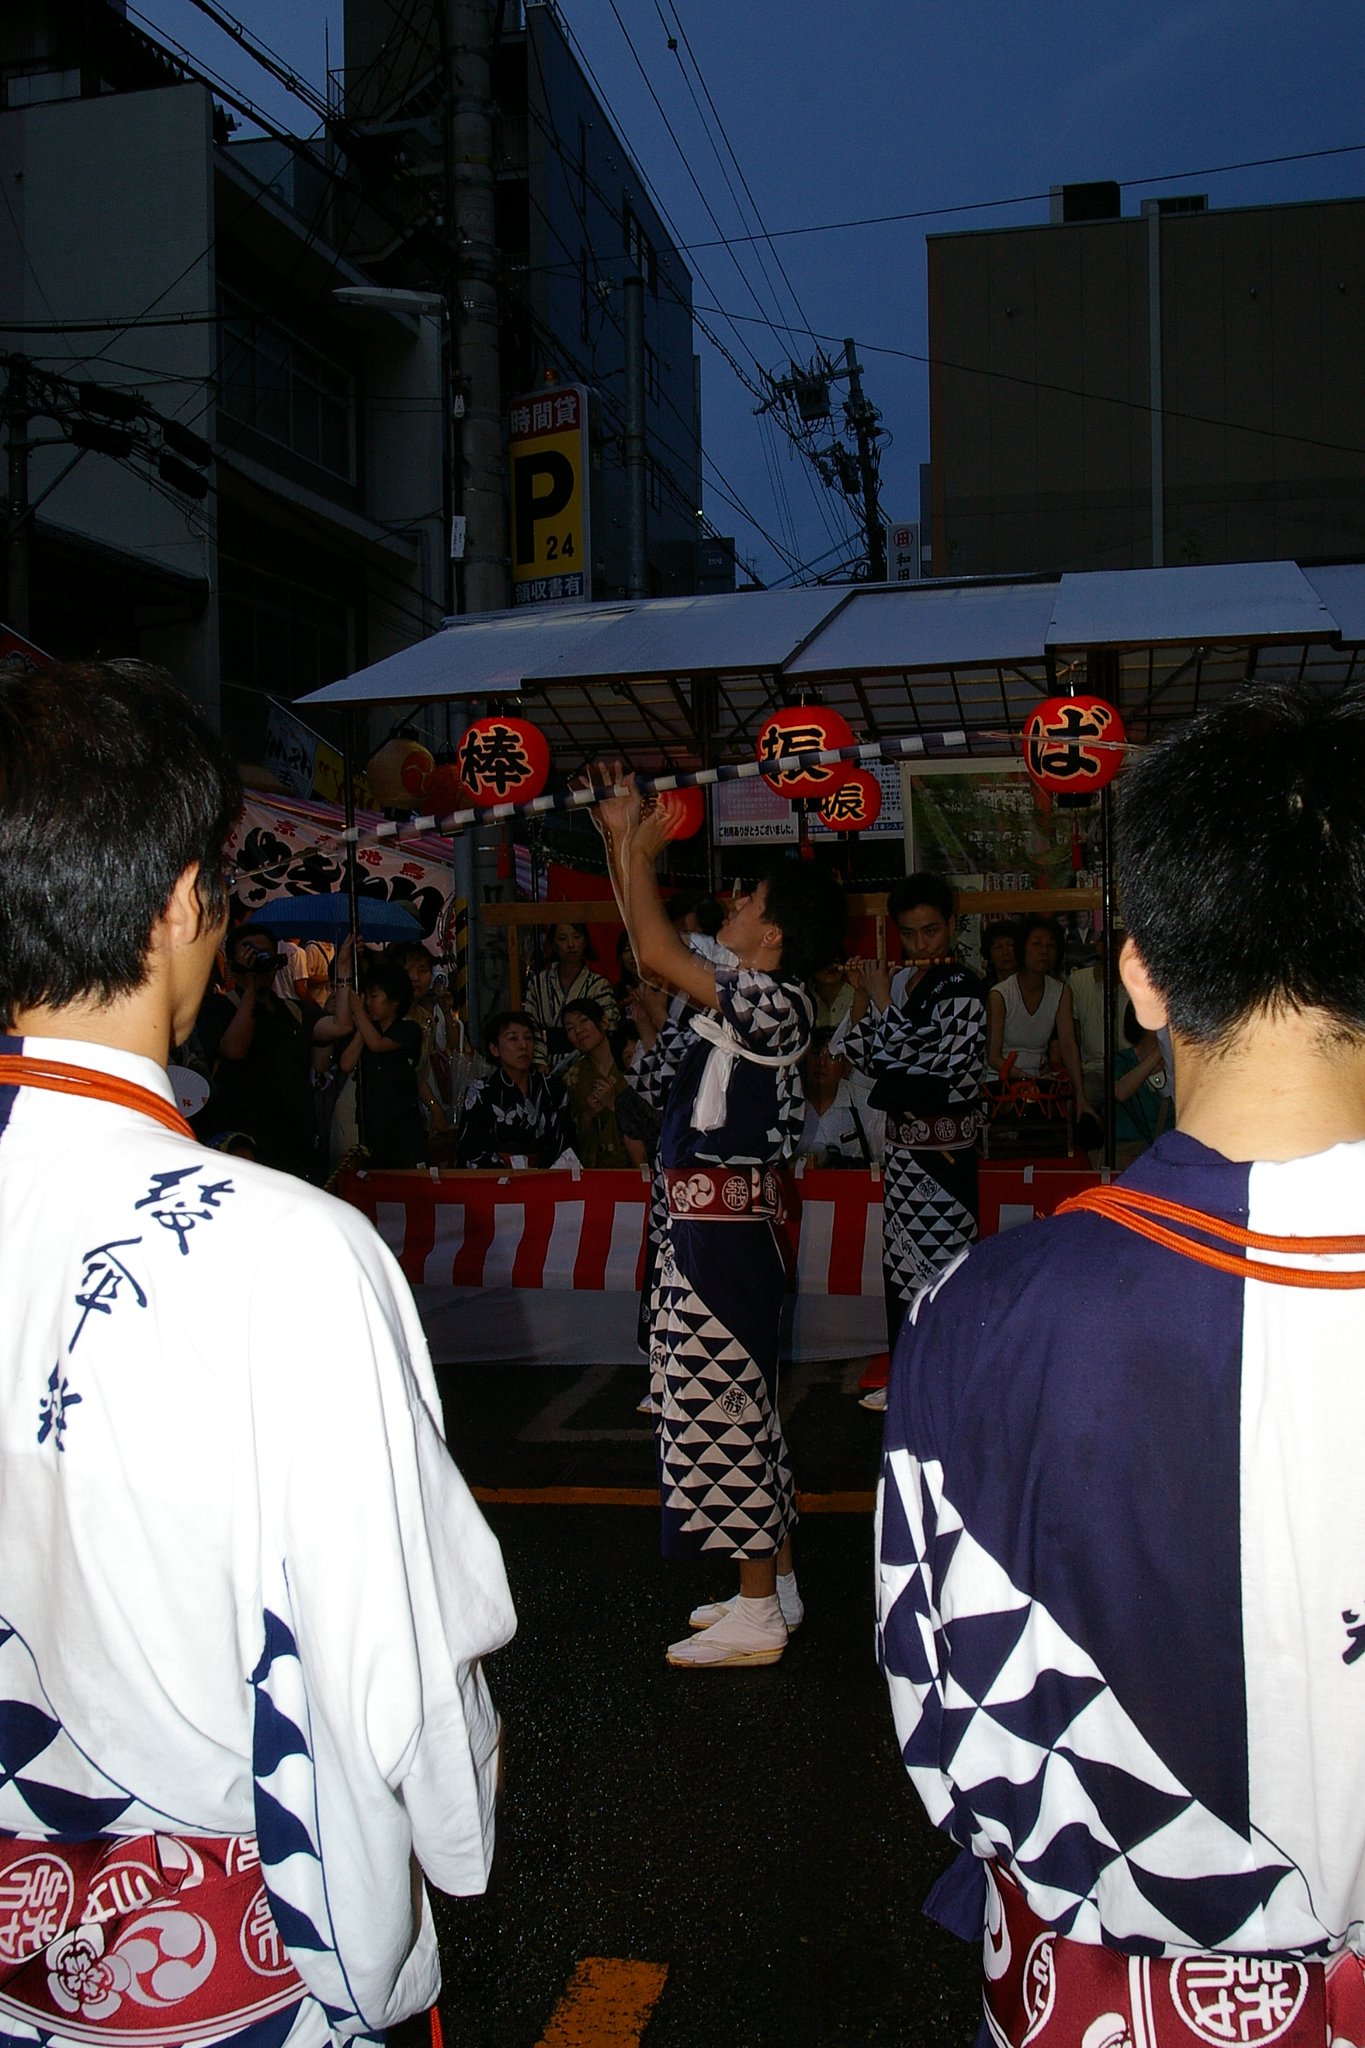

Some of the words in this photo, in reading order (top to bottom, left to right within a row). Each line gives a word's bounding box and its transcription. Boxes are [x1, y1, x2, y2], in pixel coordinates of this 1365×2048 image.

[510, 395, 577, 434] 時間貸
[515, 450, 574, 565] P
[545, 532, 575, 561] 24
[516, 575, 582, 602] 領収書有
[460, 725, 533, 797] 棒
[1027, 705, 1112, 780] ば
